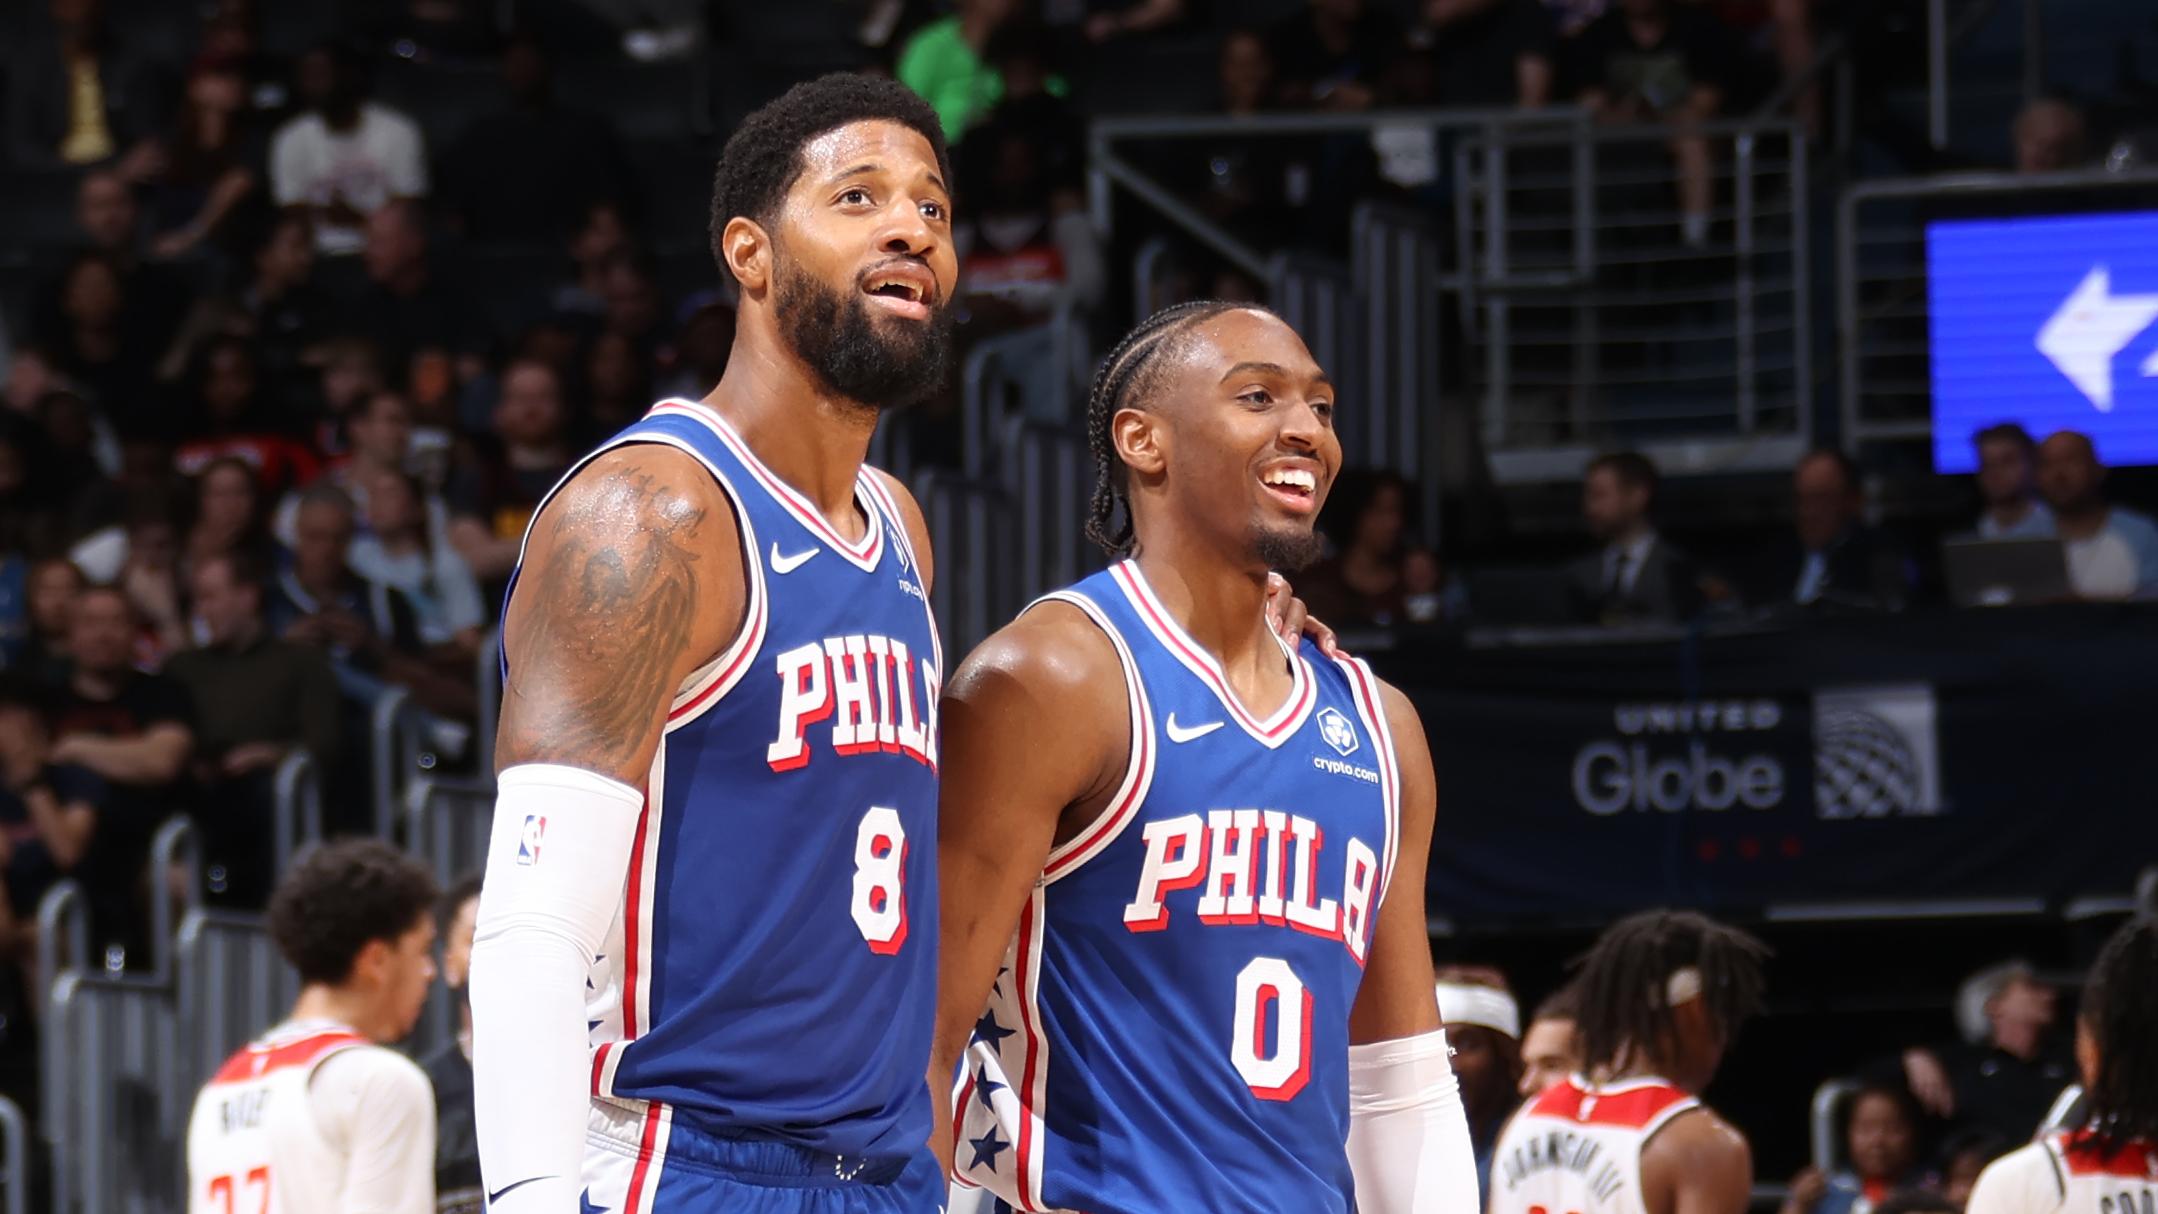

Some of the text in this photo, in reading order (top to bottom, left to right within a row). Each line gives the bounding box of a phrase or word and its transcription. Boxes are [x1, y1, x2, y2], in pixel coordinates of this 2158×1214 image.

[1313, 757, 1379, 784] crypto.com
[1614, 703, 1782, 734] UNITED
[1571, 739, 1785, 815] Globe
[851, 806, 909, 955] 8
[1123, 809, 1379, 971] PHILA
[1231, 957, 1315, 1102] 0
